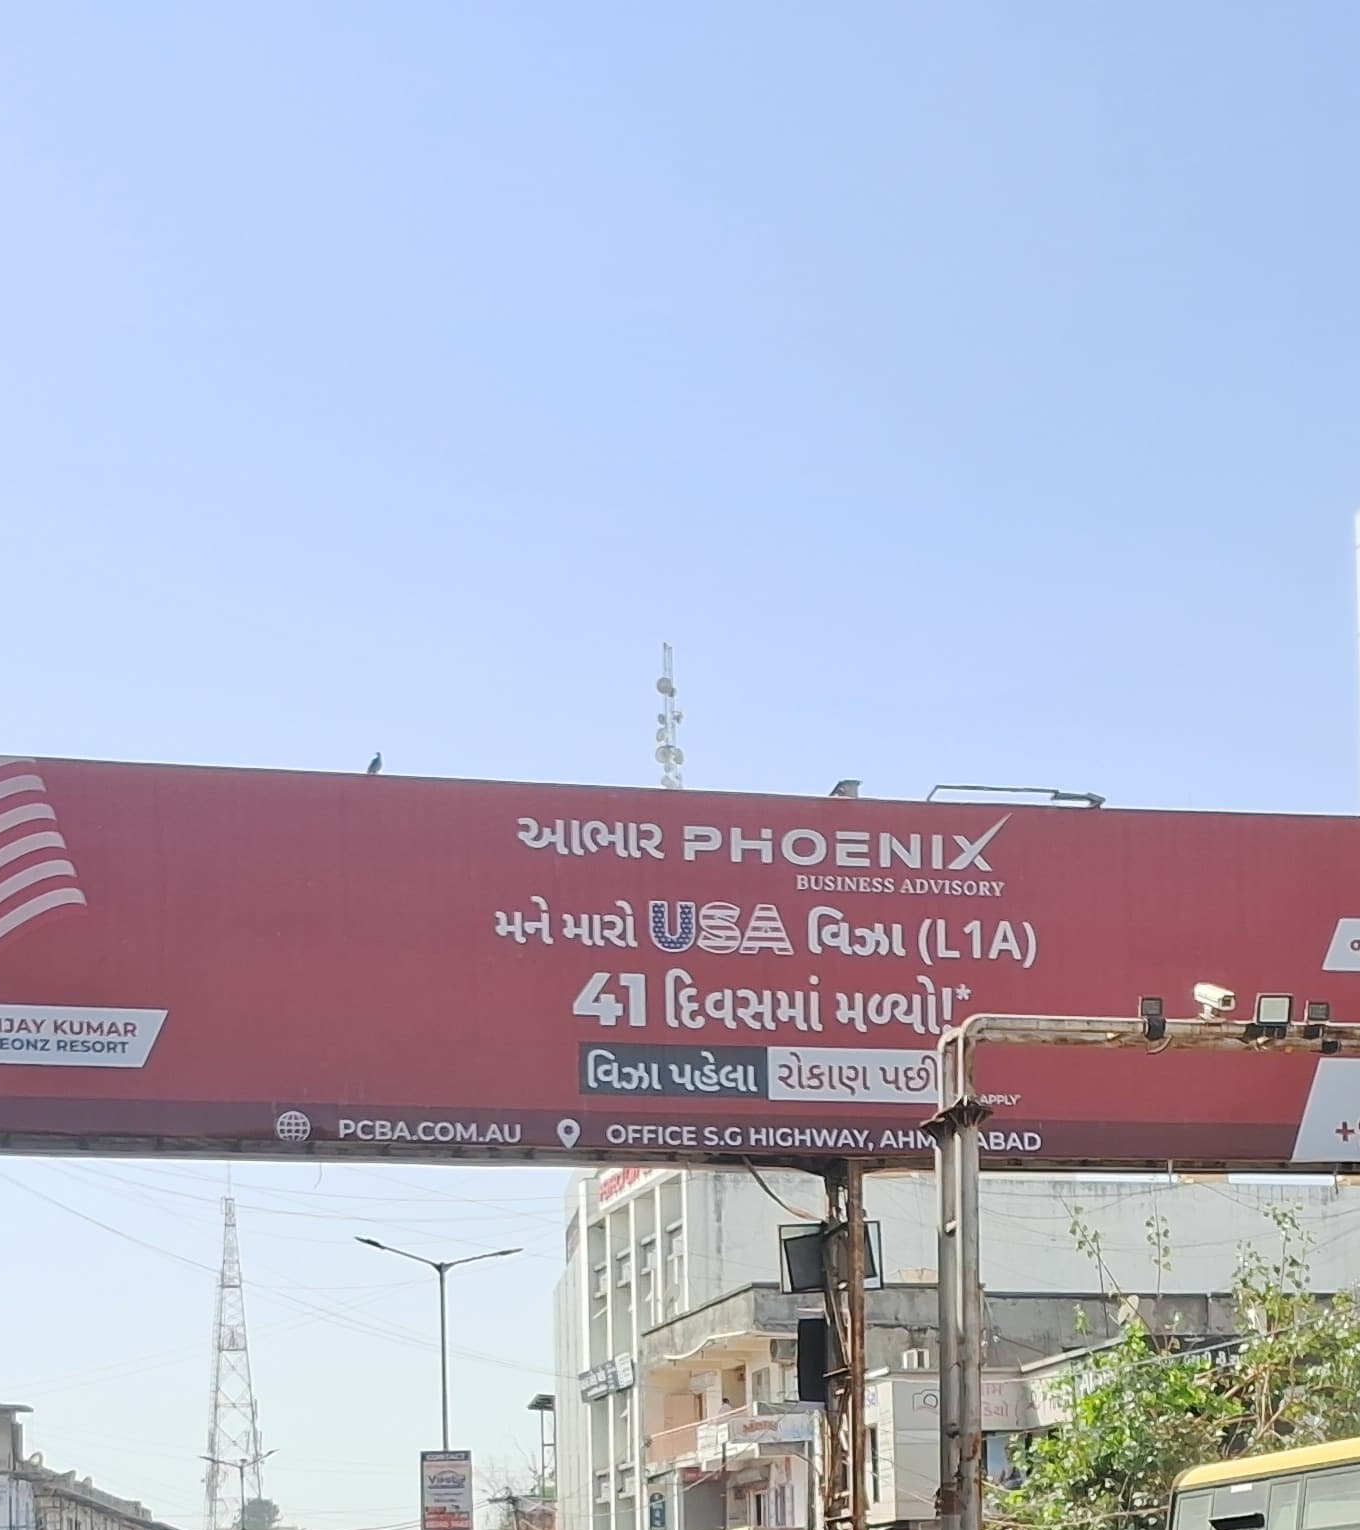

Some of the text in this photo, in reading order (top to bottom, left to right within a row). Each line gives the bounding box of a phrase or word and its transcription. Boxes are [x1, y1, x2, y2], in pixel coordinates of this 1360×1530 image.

[516, 817, 666, 859] આભાર
[683, 812, 1013, 872] PHOENIX
[795, 874, 1005, 897] BUSINESS ADVISORY
[495, 896, 1038, 969] મને મારો USA વિઝા (L1A)
[572, 972, 648, 1028] 41
[664, 968, 824, 1032] દિવસમાં
[54, 1019, 138, 1037] KUMAR
[56, 1039, 129, 1054] RESORT
[586, 1049, 662, 1090] વિઝા
[668, 1051, 759, 1093] પહેલા
[776, 1052, 871, 1095] રોકાણ
[338, 1119, 1042, 1152] PCBA.COM.AU OFFICE S.G HIGHWAY, AHMABAD
